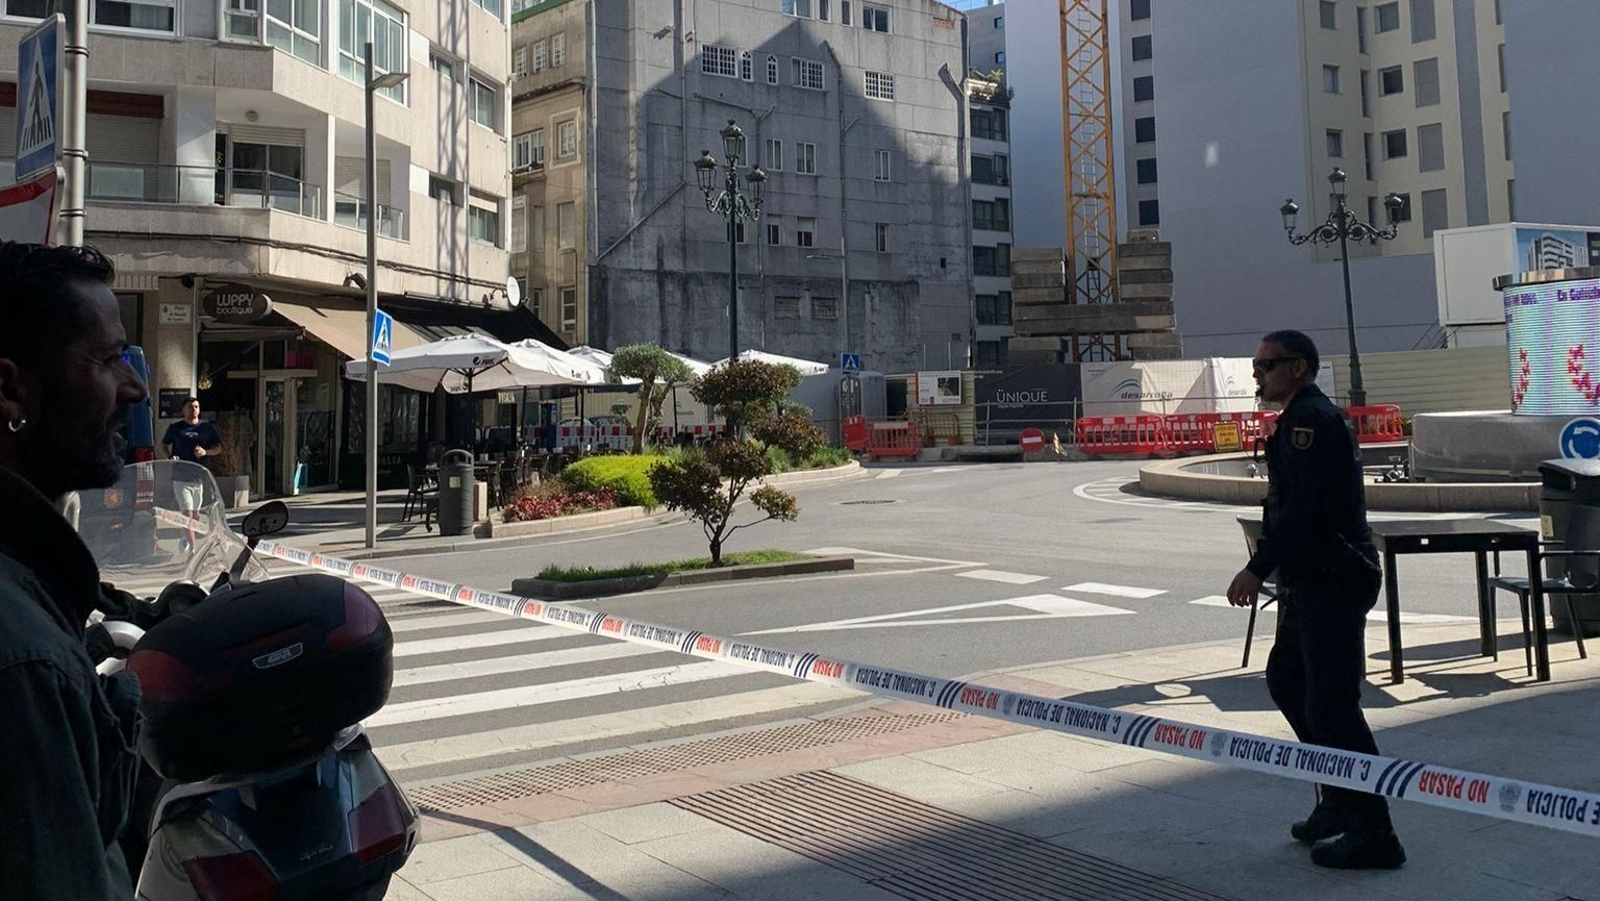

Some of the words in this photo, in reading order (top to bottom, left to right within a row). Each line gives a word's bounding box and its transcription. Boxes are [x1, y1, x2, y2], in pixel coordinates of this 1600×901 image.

[216, 293, 253, 306] LUPPY
[996, 388, 1048, 402] ÜNIQUE
[629, 623, 648, 639] POLICIA
[646, 626, 655, 640] DE
[654, 628, 676, 645] NACIONAL
[676, 632, 682, 646] C.
[696, 635, 713, 652] PASAR
[712, 639, 722, 653] NO
[730, 642, 752, 660] POLICIA
[750, 645, 760, 662] DE
[760, 648, 787, 668] NACIONAL
[787, 653, 795, 669] C.
[813, 658, 833, 677] PASAR
[832, 663, 845, 679] NO
[856, 666, 883, 688] POLICIA
[881, 671, 893, 690] DE
[893, 674, 929, 696] NACIONAL
[929, 681, 937, 698] C.
[960, 687, 988, 707] PASAR
[987, 692, 1001, 710] NO
[1016, 697, 1051, 721] POLICIA
[1049, 703, 1064, 725] DE
[1065, 707, 1111, 732] NACIONAL
[1112, 715, 1122, 734] C.
[1154, 723, 1193, 747] PASAR
[1189, 731, 1207, 750] NO
[1229, 736, 1276, 763] POLICIA
[1275, 745, 1292, 767] DE
[1295, 748, 1356, 779] NACIONAL
[1360, 759, 1372, 781] C.
[1419, 770, 1466, 800] PASAR
[1467, 780, 1491, 804] NO
[1527, 788, 1589, 823] POLICIA
